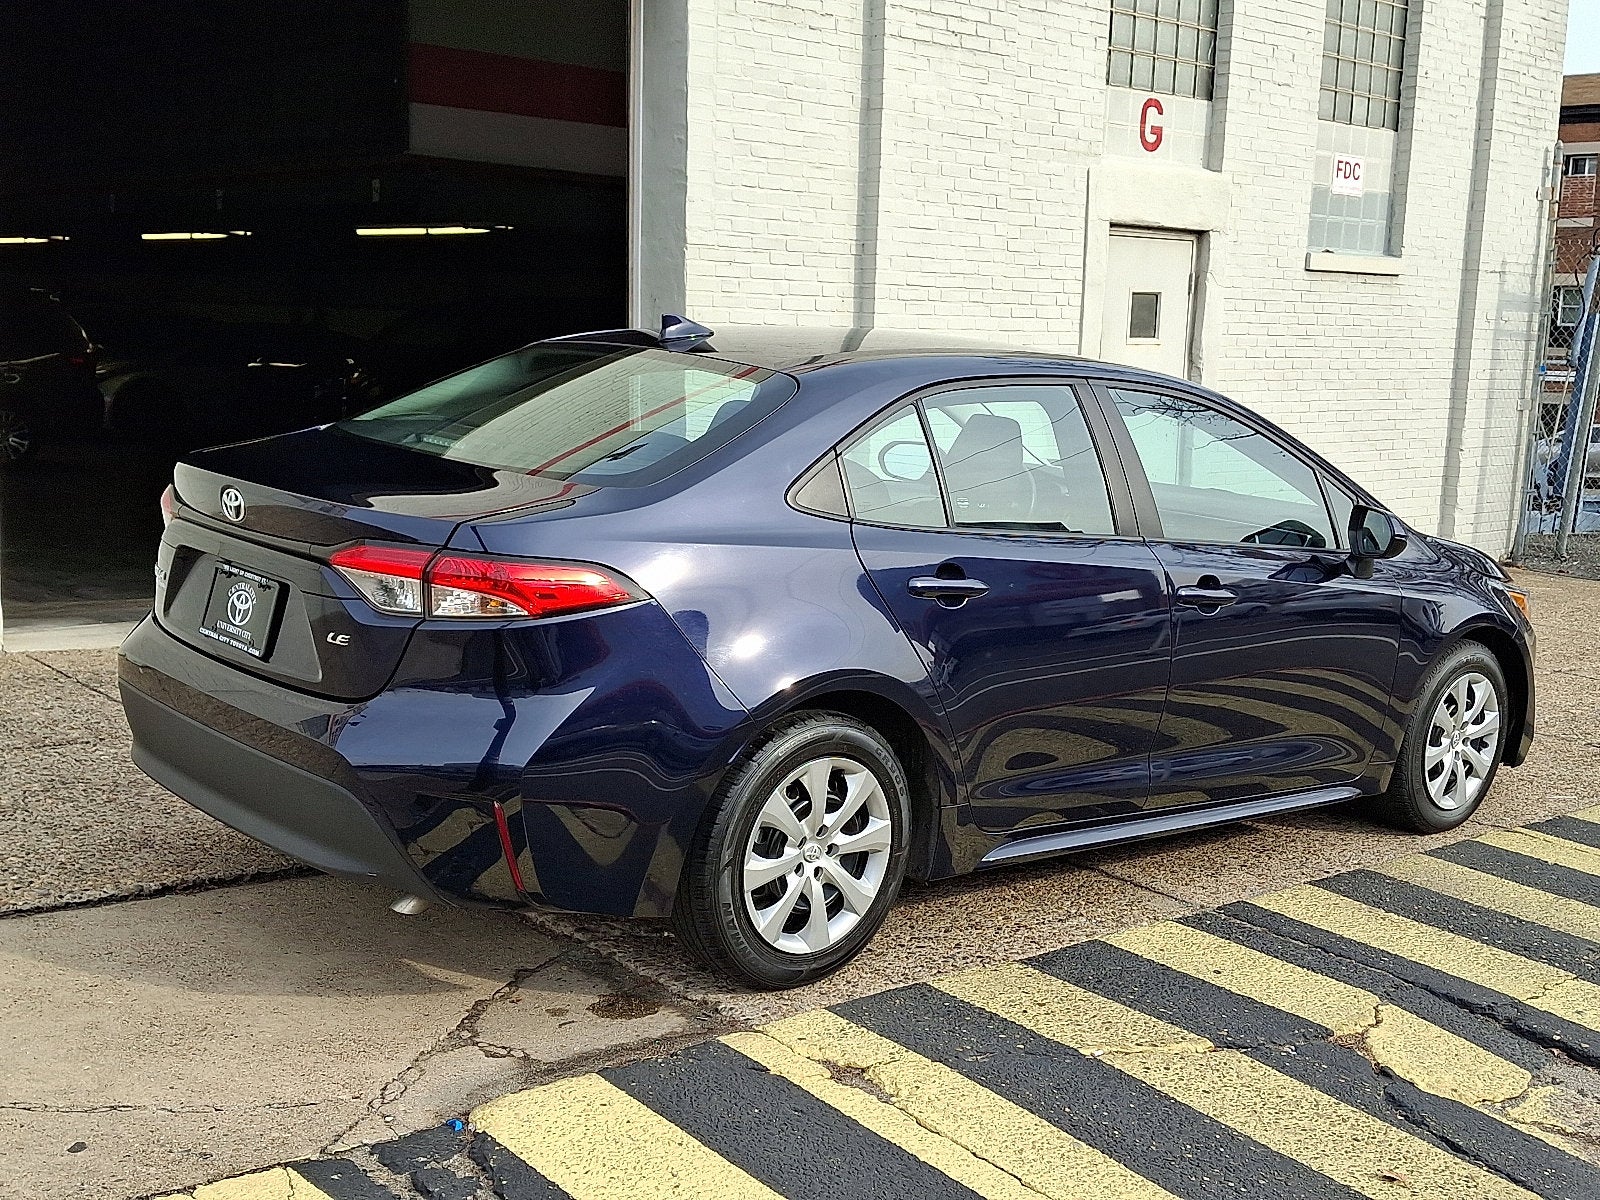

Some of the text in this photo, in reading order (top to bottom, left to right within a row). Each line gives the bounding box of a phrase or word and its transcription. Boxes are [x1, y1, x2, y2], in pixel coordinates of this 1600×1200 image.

[1139, 97, 1164, 152] G
[1336, 159, 1361, 181] FDC
[216, 620, 242, 637] UNIVERSITY
[218, 635, 230, 644] CITY
[326, 631, 351, 646] LE
